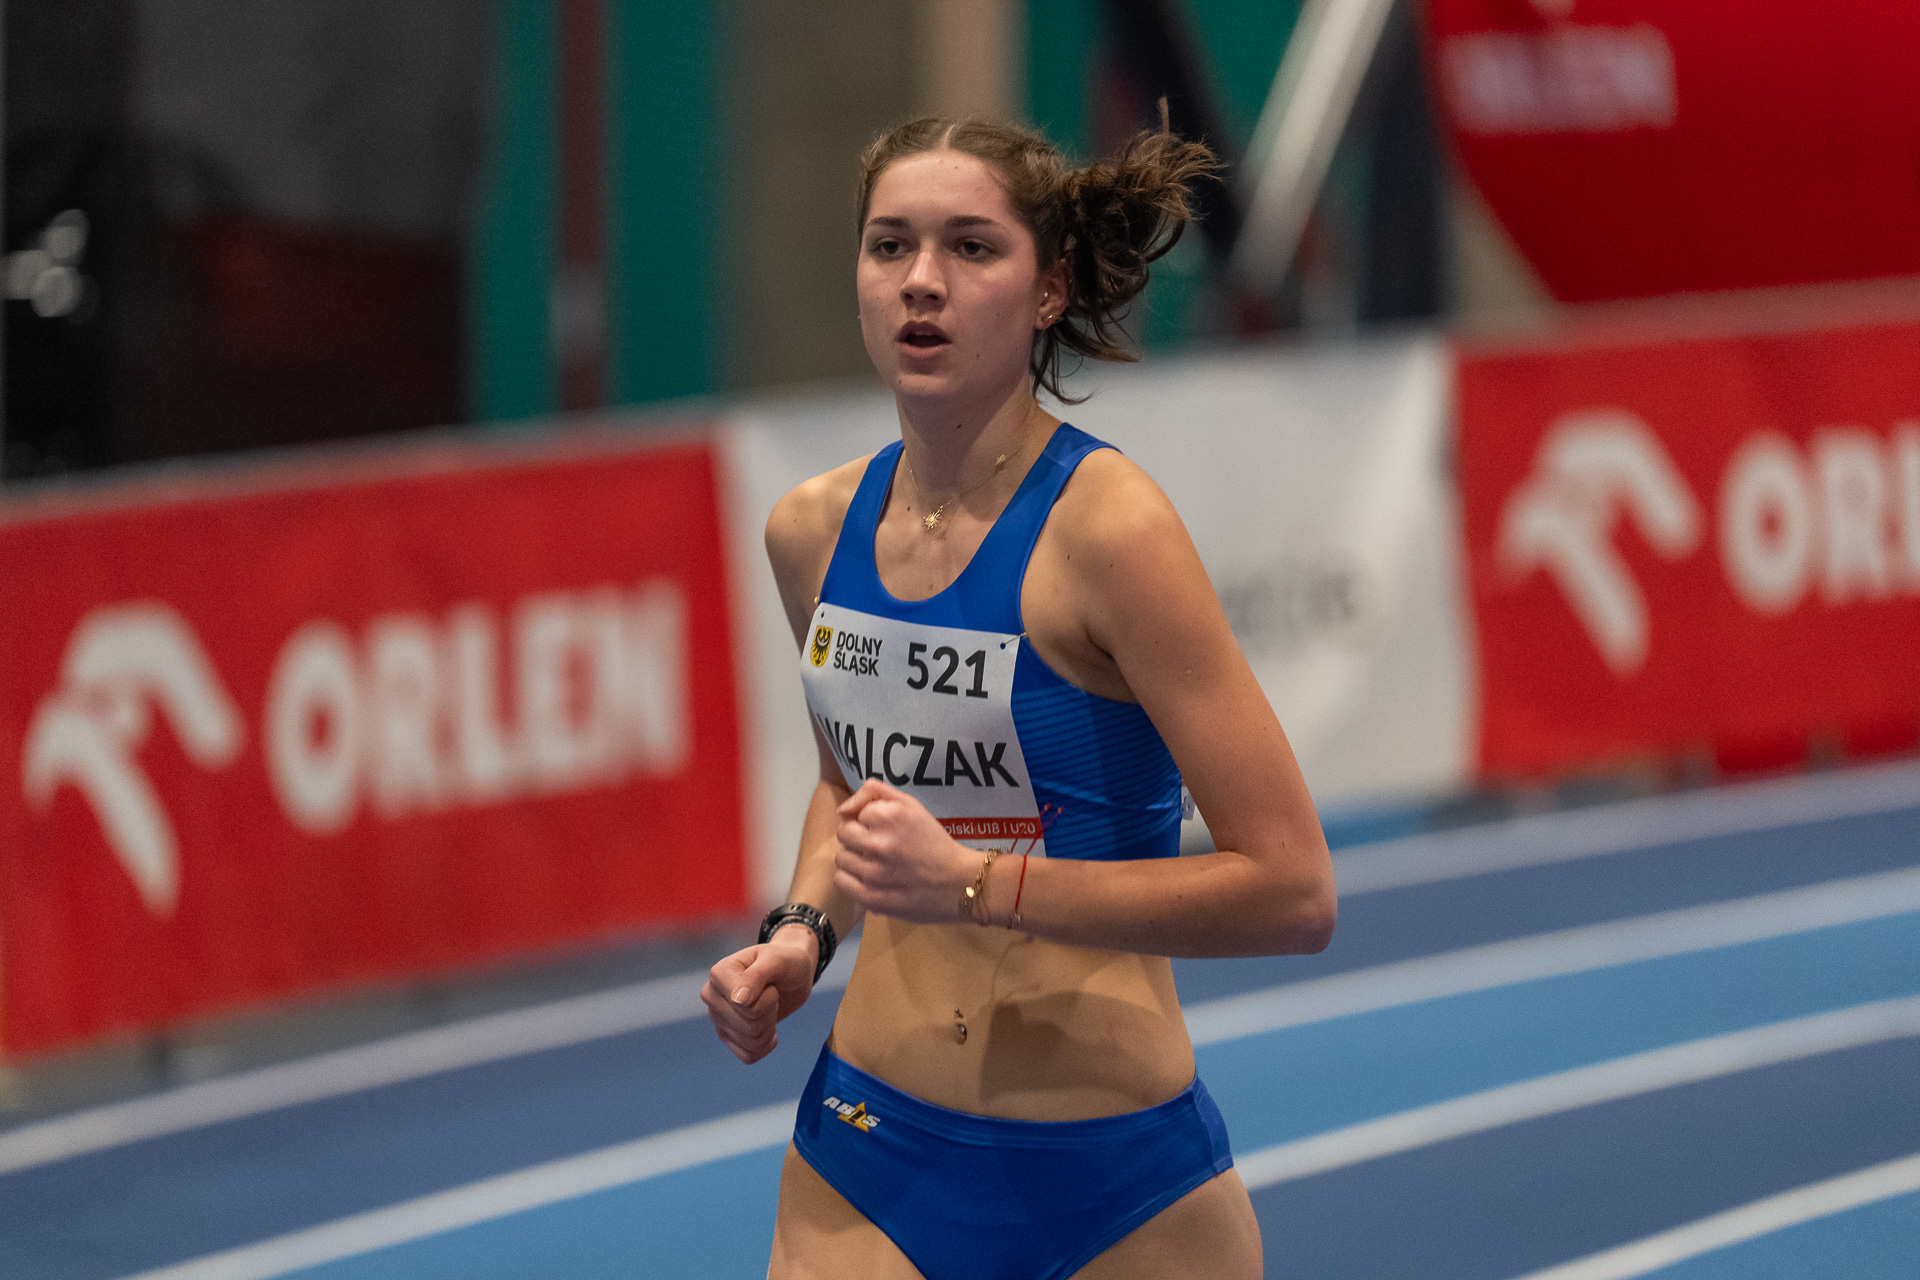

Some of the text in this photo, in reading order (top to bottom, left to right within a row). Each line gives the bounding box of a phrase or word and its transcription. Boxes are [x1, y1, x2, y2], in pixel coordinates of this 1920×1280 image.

[837, 631, 883, 657] DOLNY
[833, 646, 879, 677] ŚLĄSK
[906, 641, 989, 699] 521
[268, 580, 692, 834] ORLEN
[944, 822, 1036, 835] olski U18 i U20
